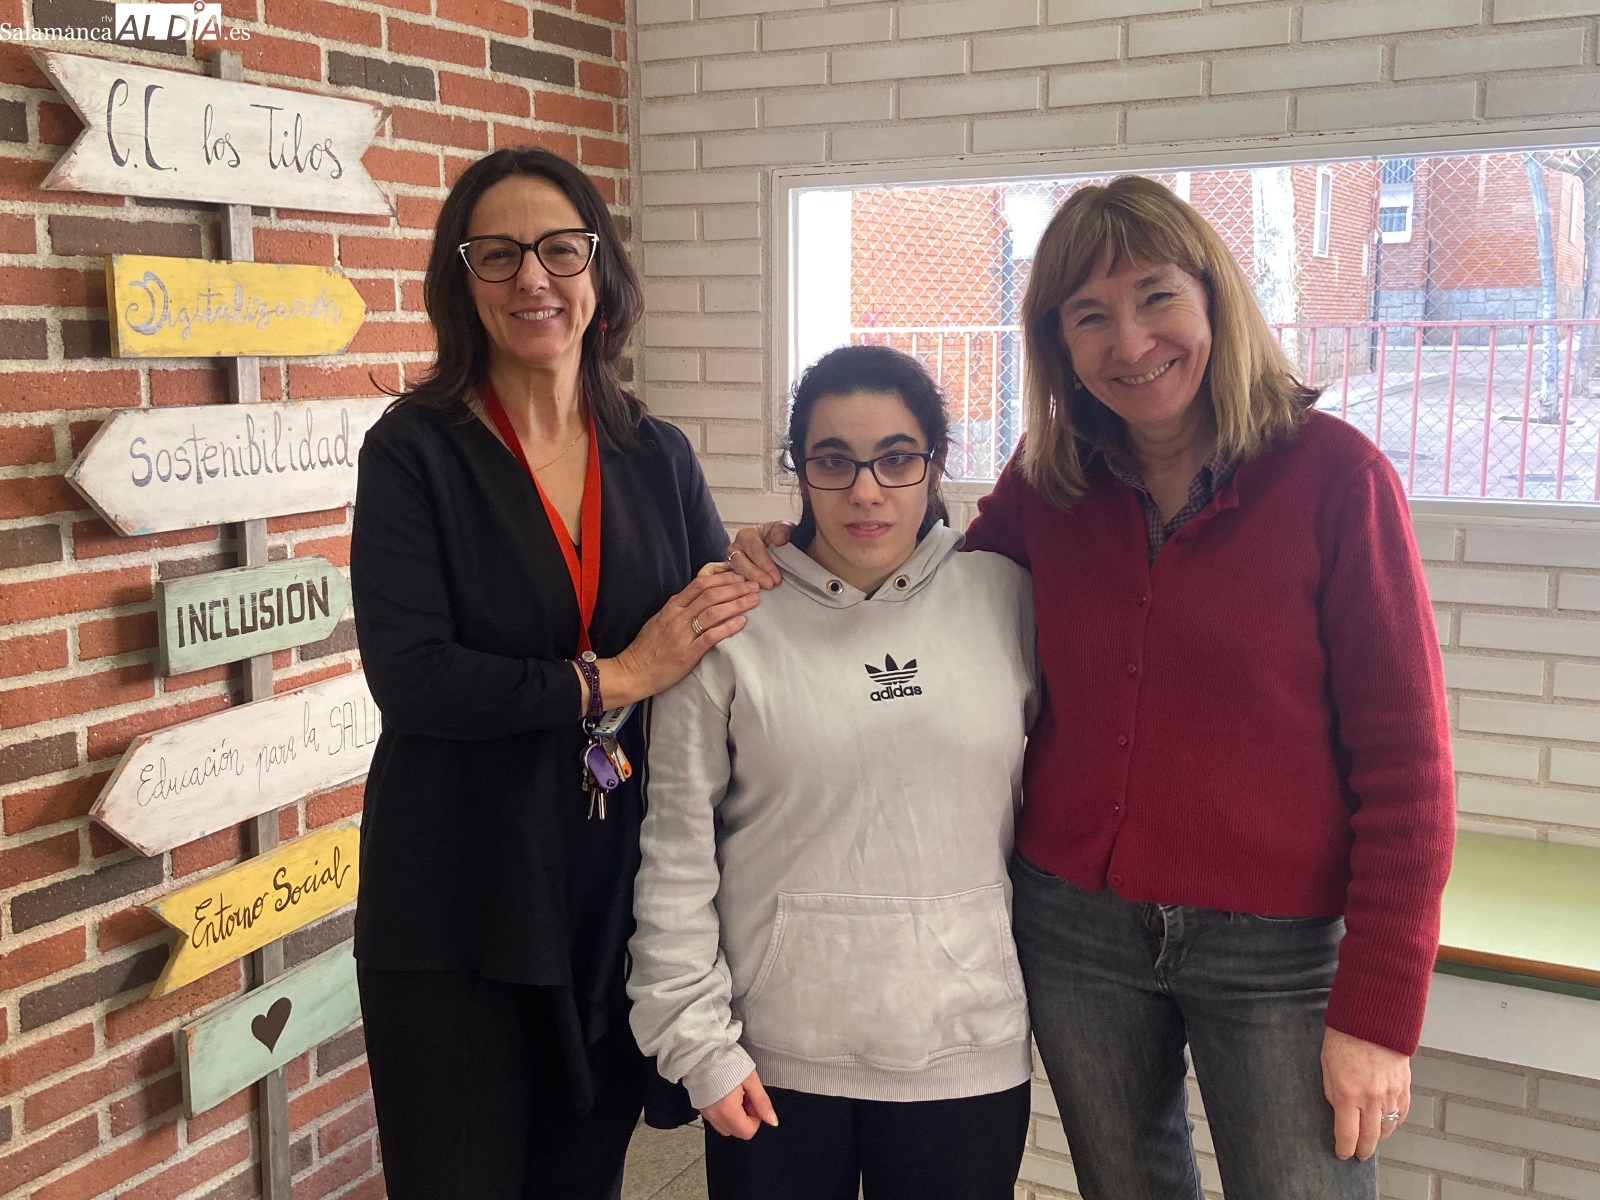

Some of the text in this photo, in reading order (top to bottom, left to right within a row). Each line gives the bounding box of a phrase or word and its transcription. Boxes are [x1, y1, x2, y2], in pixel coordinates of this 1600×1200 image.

[106, 78, 178, 172] C.C.
[250, 103, 345, 180] Tilos
[125, 271, 342, 340] Digitalización
[129, 407, 354, 487] Sostenibilidad
[177, 575, 330, 648] INCLUSIÓN
[870, 685, 922, 701] adidas
[136, 738, 244, 807] Educación
[256, 735, 296, 793] para
[303, 702, 320, 752] la
[191, 846, 351, 949] Entorno Social
